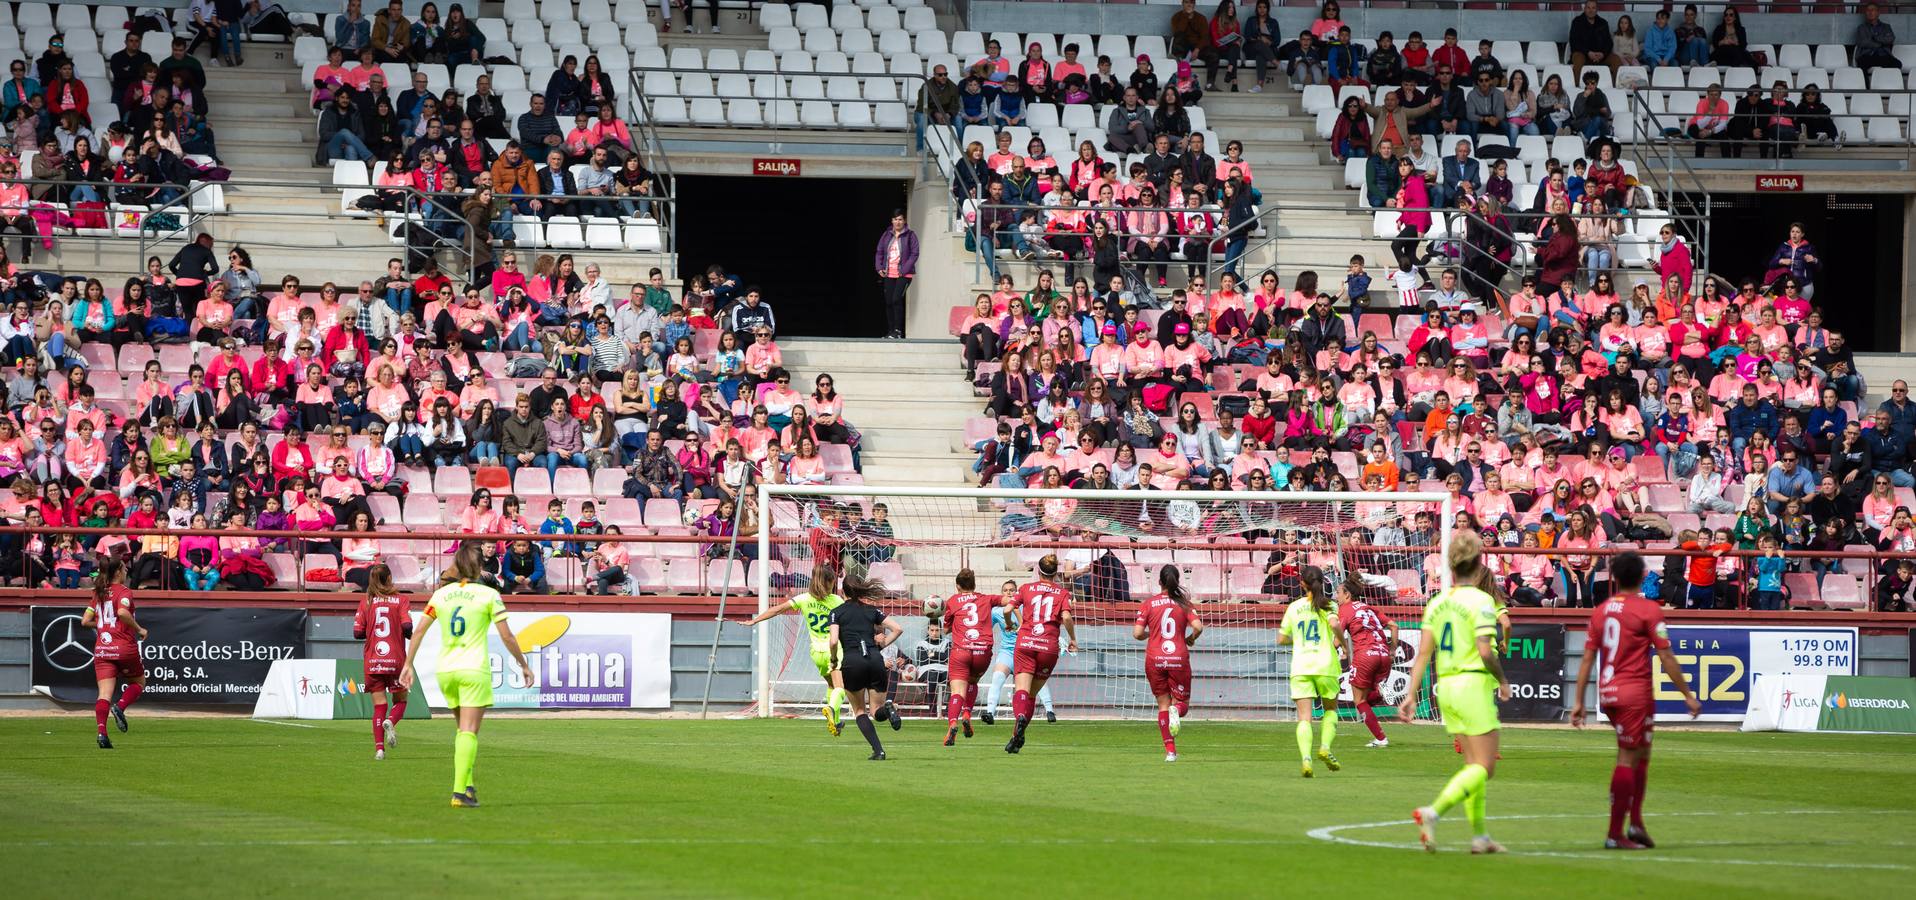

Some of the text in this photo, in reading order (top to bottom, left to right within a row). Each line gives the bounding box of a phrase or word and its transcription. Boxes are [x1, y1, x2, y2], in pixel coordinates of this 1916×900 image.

[274, 51, 284, 60] 21
[758, 162, 797, 172] SALIDA
[1760, 178, 1799, 188] SALIDA
[372, 596, 400, 604] SANANA
[1151, 598, 1171, 608] SILVIA
[95, 600, 118, 629] 14
[961, 602, 979, 627] 3
[1031, 595, 1054, 623] 11
[375, 606, 391, 638] 5
[450, 606, 466, 637] 6
[808, 612, 831, 633] 22
[1160, 607, 1176, 640] 6
[1297, 619, 1321, 644] 14
[1440, 621, 1454, 655] 4
[1603, 616, 1621, 663] 9
[1782, 639, 1848, 651] 1.179 OM
[1505, 638, 1545, 659] FM
[1793, 655, 1848, 667] 99.8 FM
[153, 666, 178, 681] Oja,
[183, 666, 209, 679] S.A.
[121, 683, 188, 694] Cesionario
[190, 683, 222, 693] Oficial
[309, 685, 332, 695] LIGA
[556, 693, 567, 702] DEL
[569, 693, 590, 702] MEDIO
[592, 693, 624, 702] AMBIENTE
[1794, 698, 1819, 708] LIGA
[1848, 698, 1910, 709] IBERDROLA
